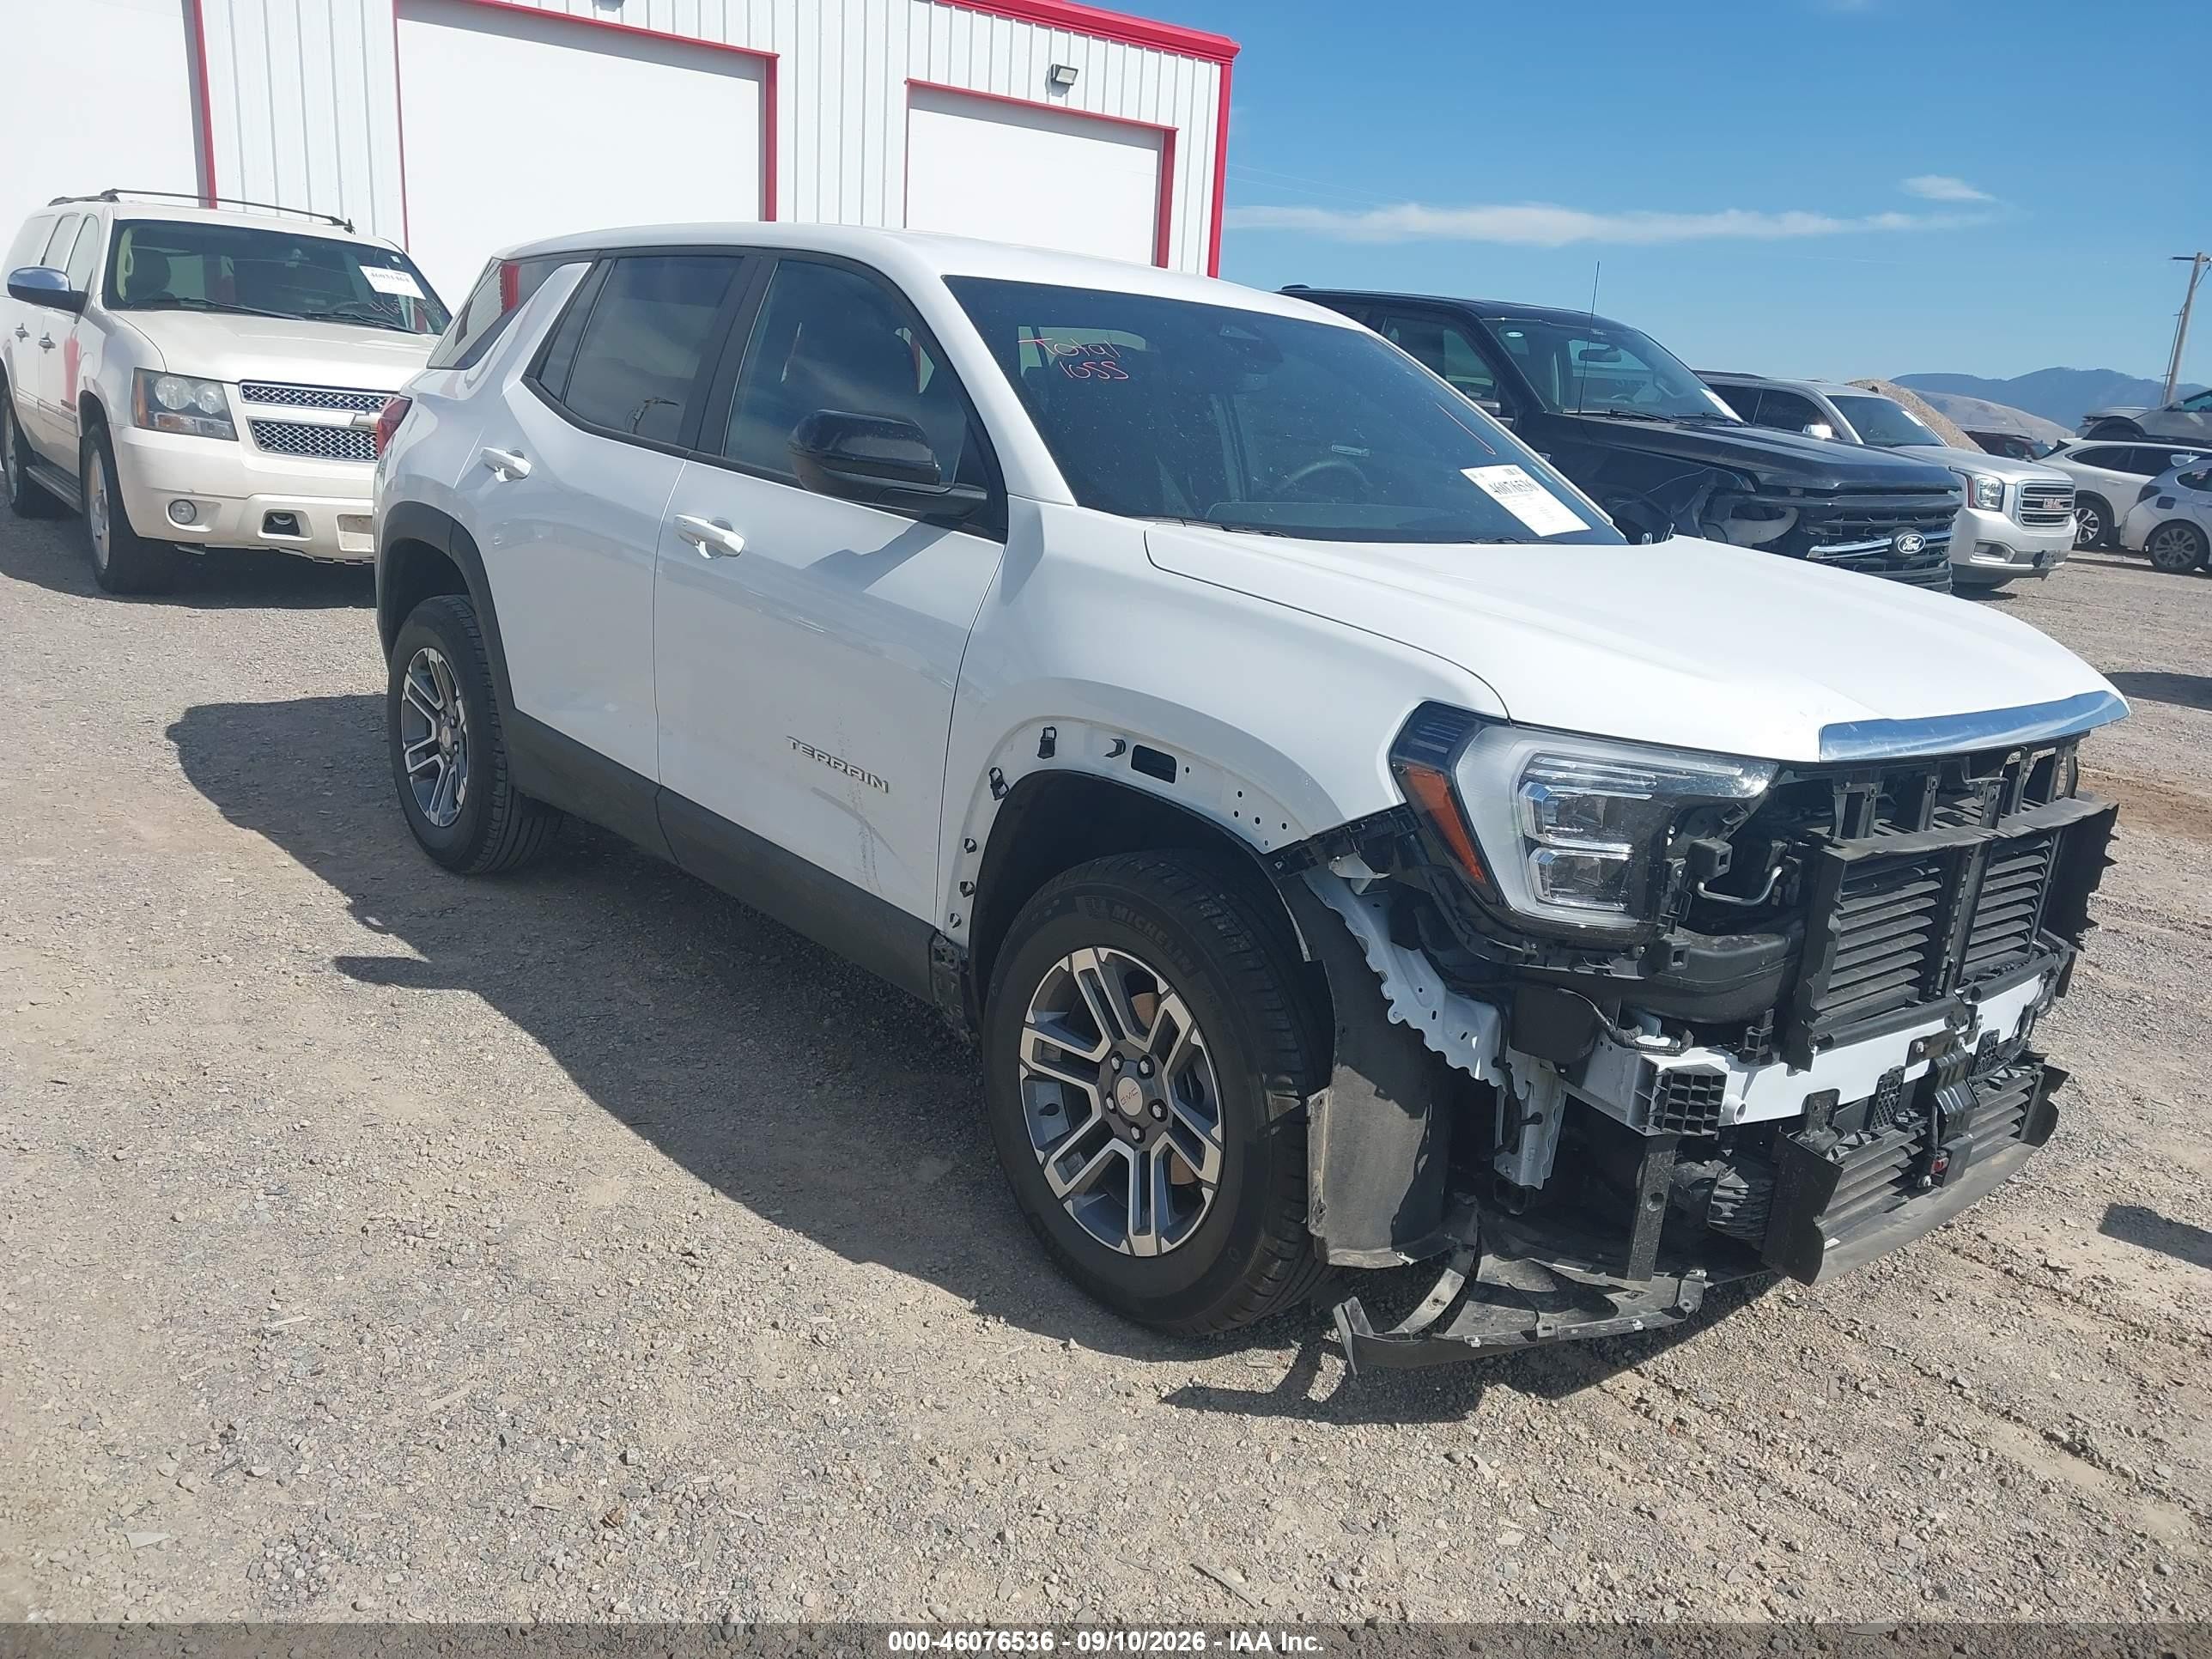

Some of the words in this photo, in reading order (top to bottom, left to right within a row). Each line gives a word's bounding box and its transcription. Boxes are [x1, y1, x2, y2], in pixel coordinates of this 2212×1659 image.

[1018, 337, 1121, 359] Total
[1902, 536, 1922, 550] Ford
[785, 735, 889, 793] TERRAIN
[1112, 904, 1196, 974] MICHELIN
[1120, 1087, 1139, 1106] GMC
